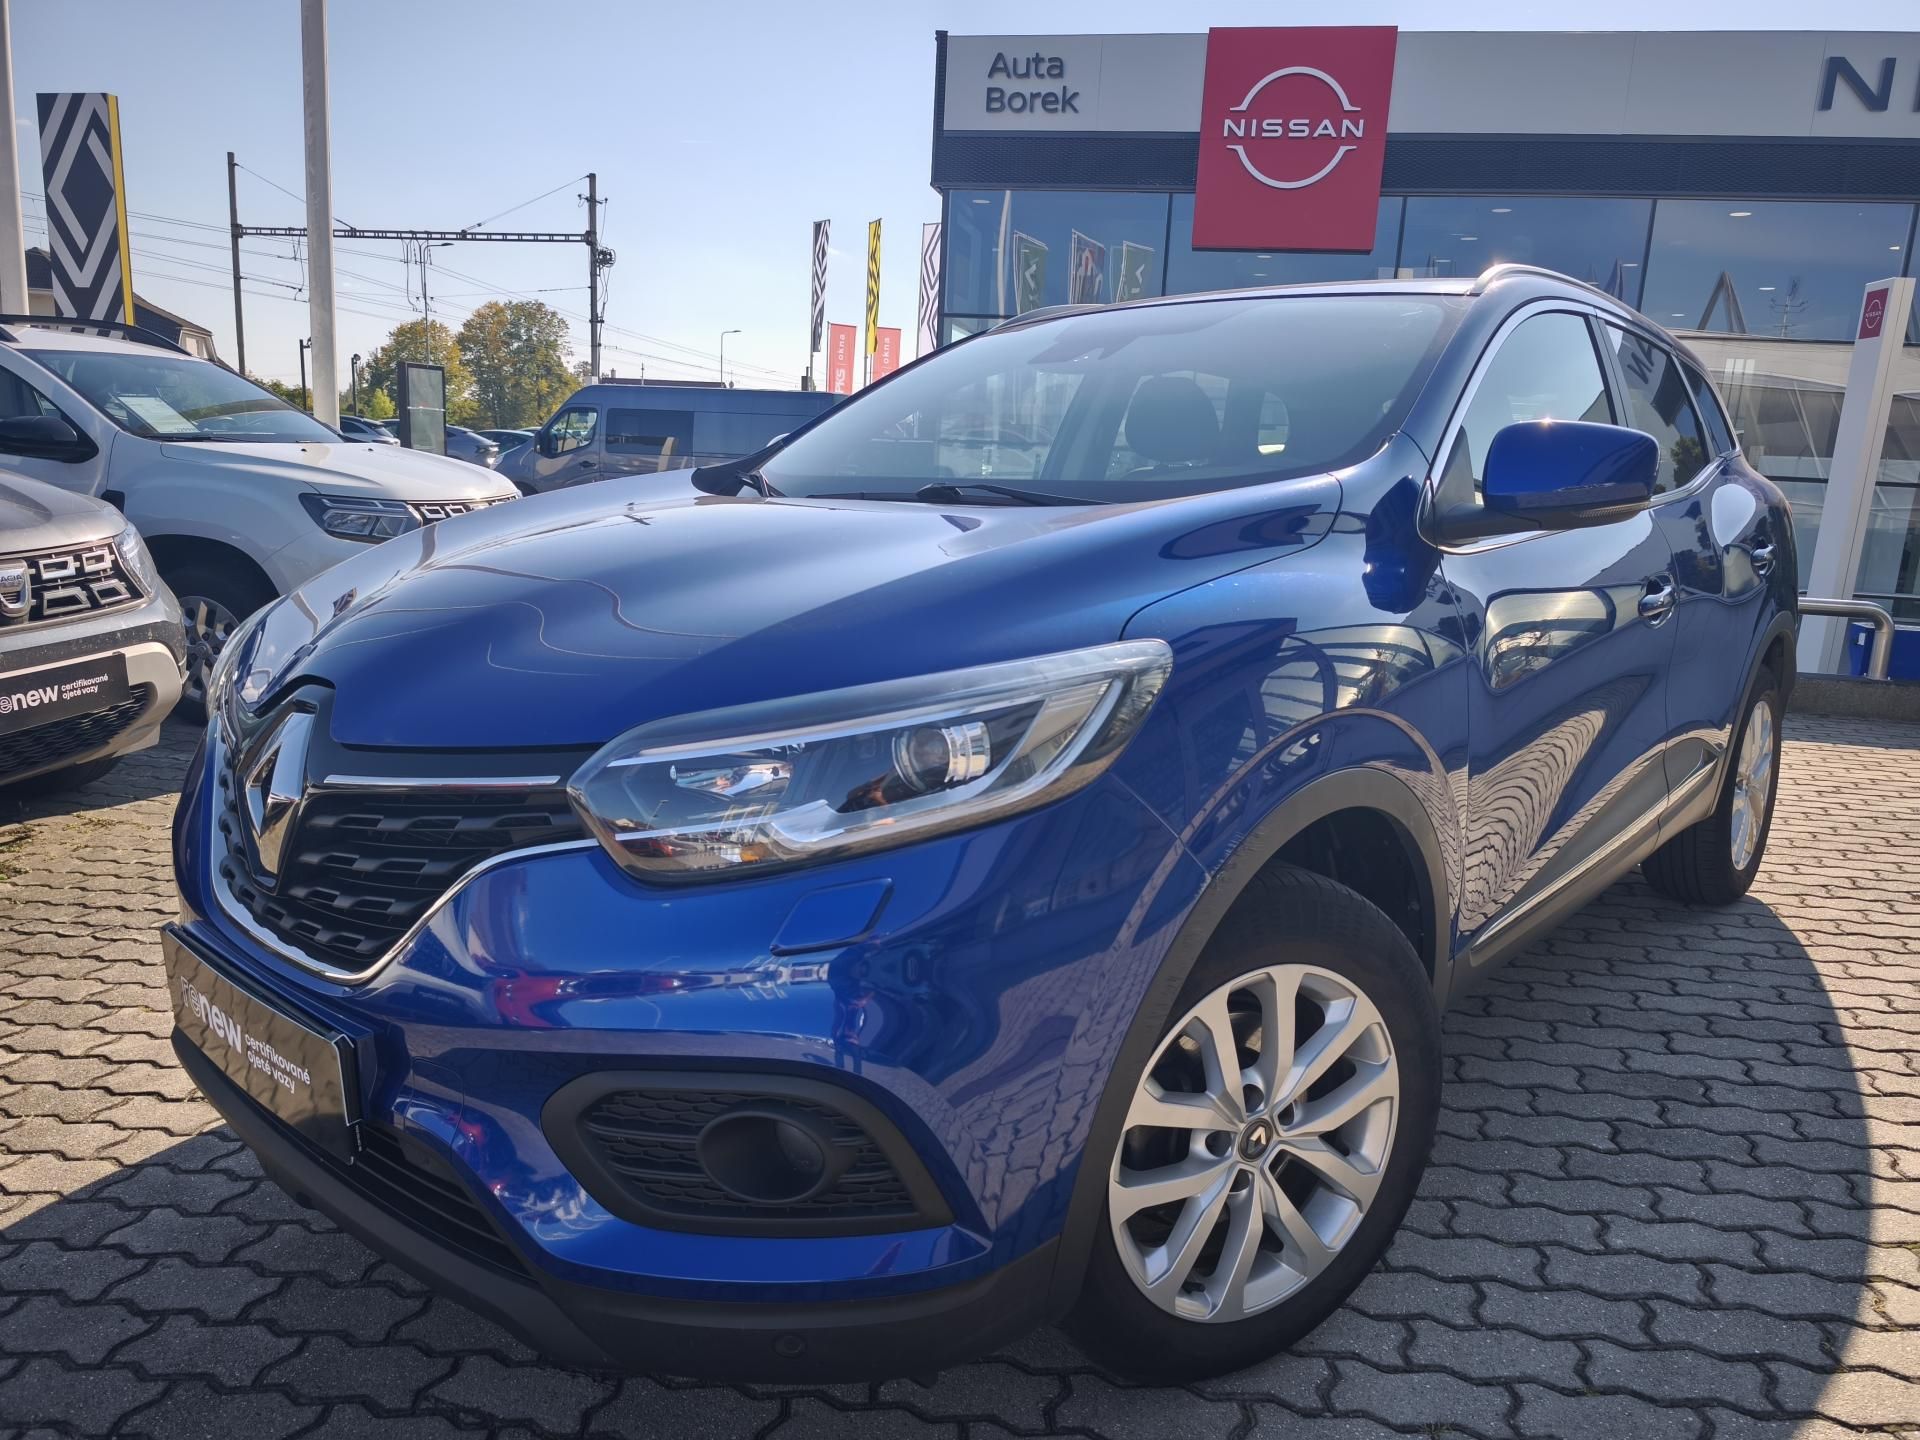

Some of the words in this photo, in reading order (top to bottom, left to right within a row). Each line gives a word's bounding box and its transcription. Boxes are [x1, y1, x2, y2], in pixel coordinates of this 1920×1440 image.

[987, 52, 1064, 79] Auta
[985, 85, 1080, 114] Borek
[1223, 118, 1364, 138] NISSAN
[837, 334, 846, 361] okna
[882, 337, 890, 364] okna
[0, 574, 23, 583] ACIA
[0, 684, 59, 714] enew
[61, 673, 109, 691] certifikované
[81, 684, 98, 694] vozy
[244, 1033, 311, 1085] certifikované
[247, 1049, 272, 1075] ojeté
[271, 1066, 296, 1094] vozy
